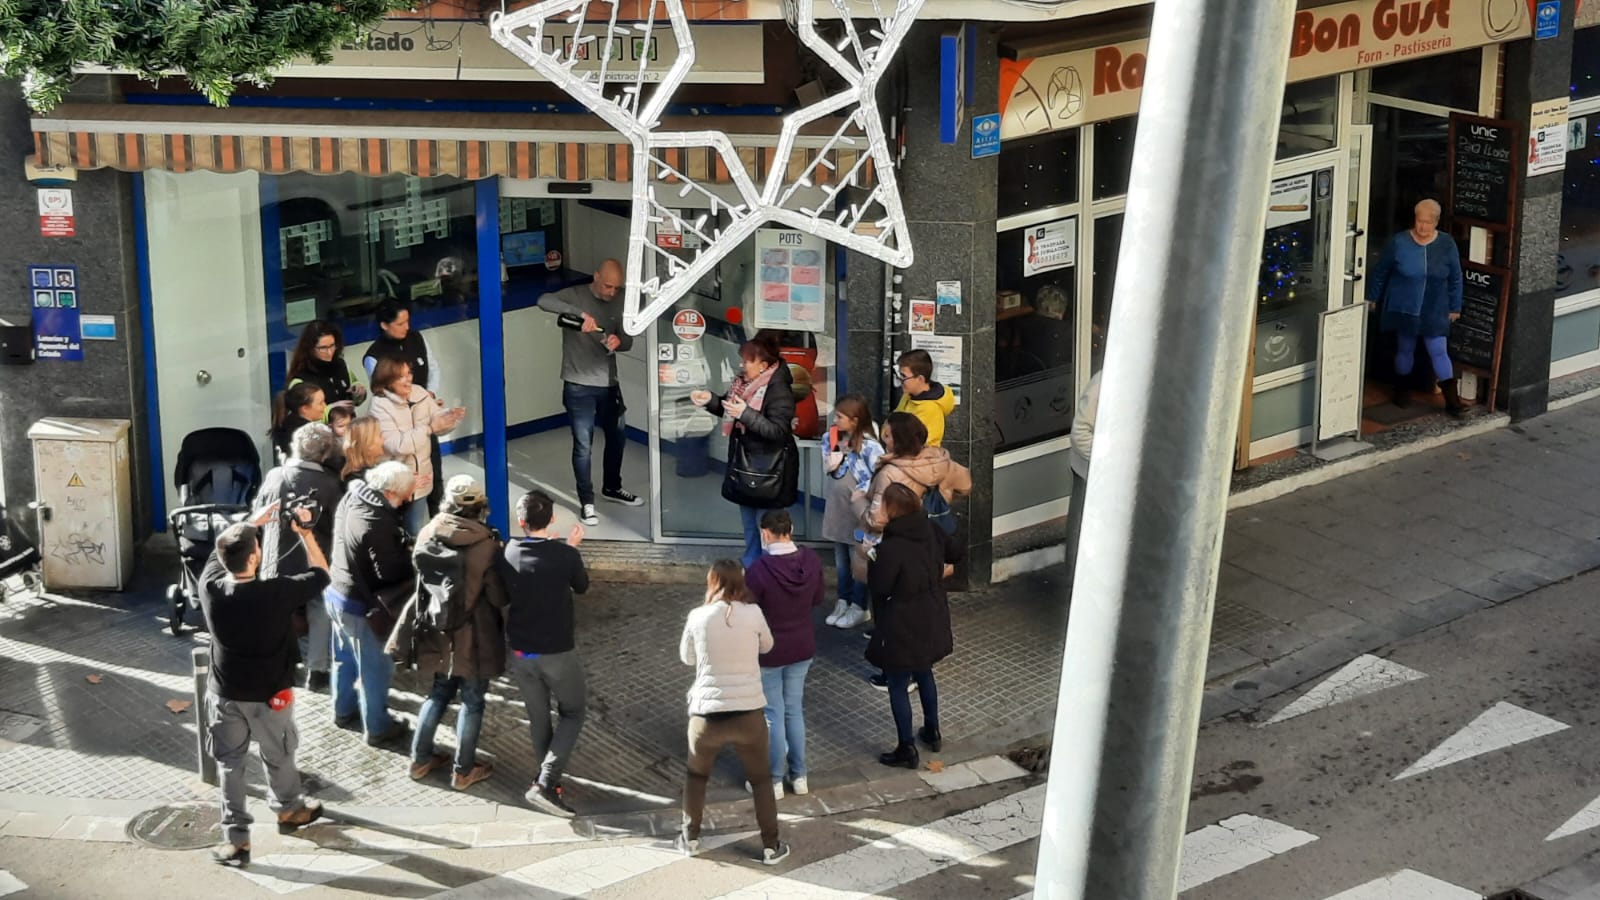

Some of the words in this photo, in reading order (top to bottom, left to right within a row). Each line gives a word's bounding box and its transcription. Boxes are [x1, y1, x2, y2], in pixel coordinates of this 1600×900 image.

[341, 32, 414, 51] tado
[1093, 45, 1147, 97] Ra
[1289, 11, 1361, 59] Bon
[1372, 0, 1451, 41] Gust
[1357, 50, 1382, 65] Forn
[1393, 35, 1452, 58] Pastisseria
[654, 72, 660, 80] 2
[779, 232, 803, 244] POTS
